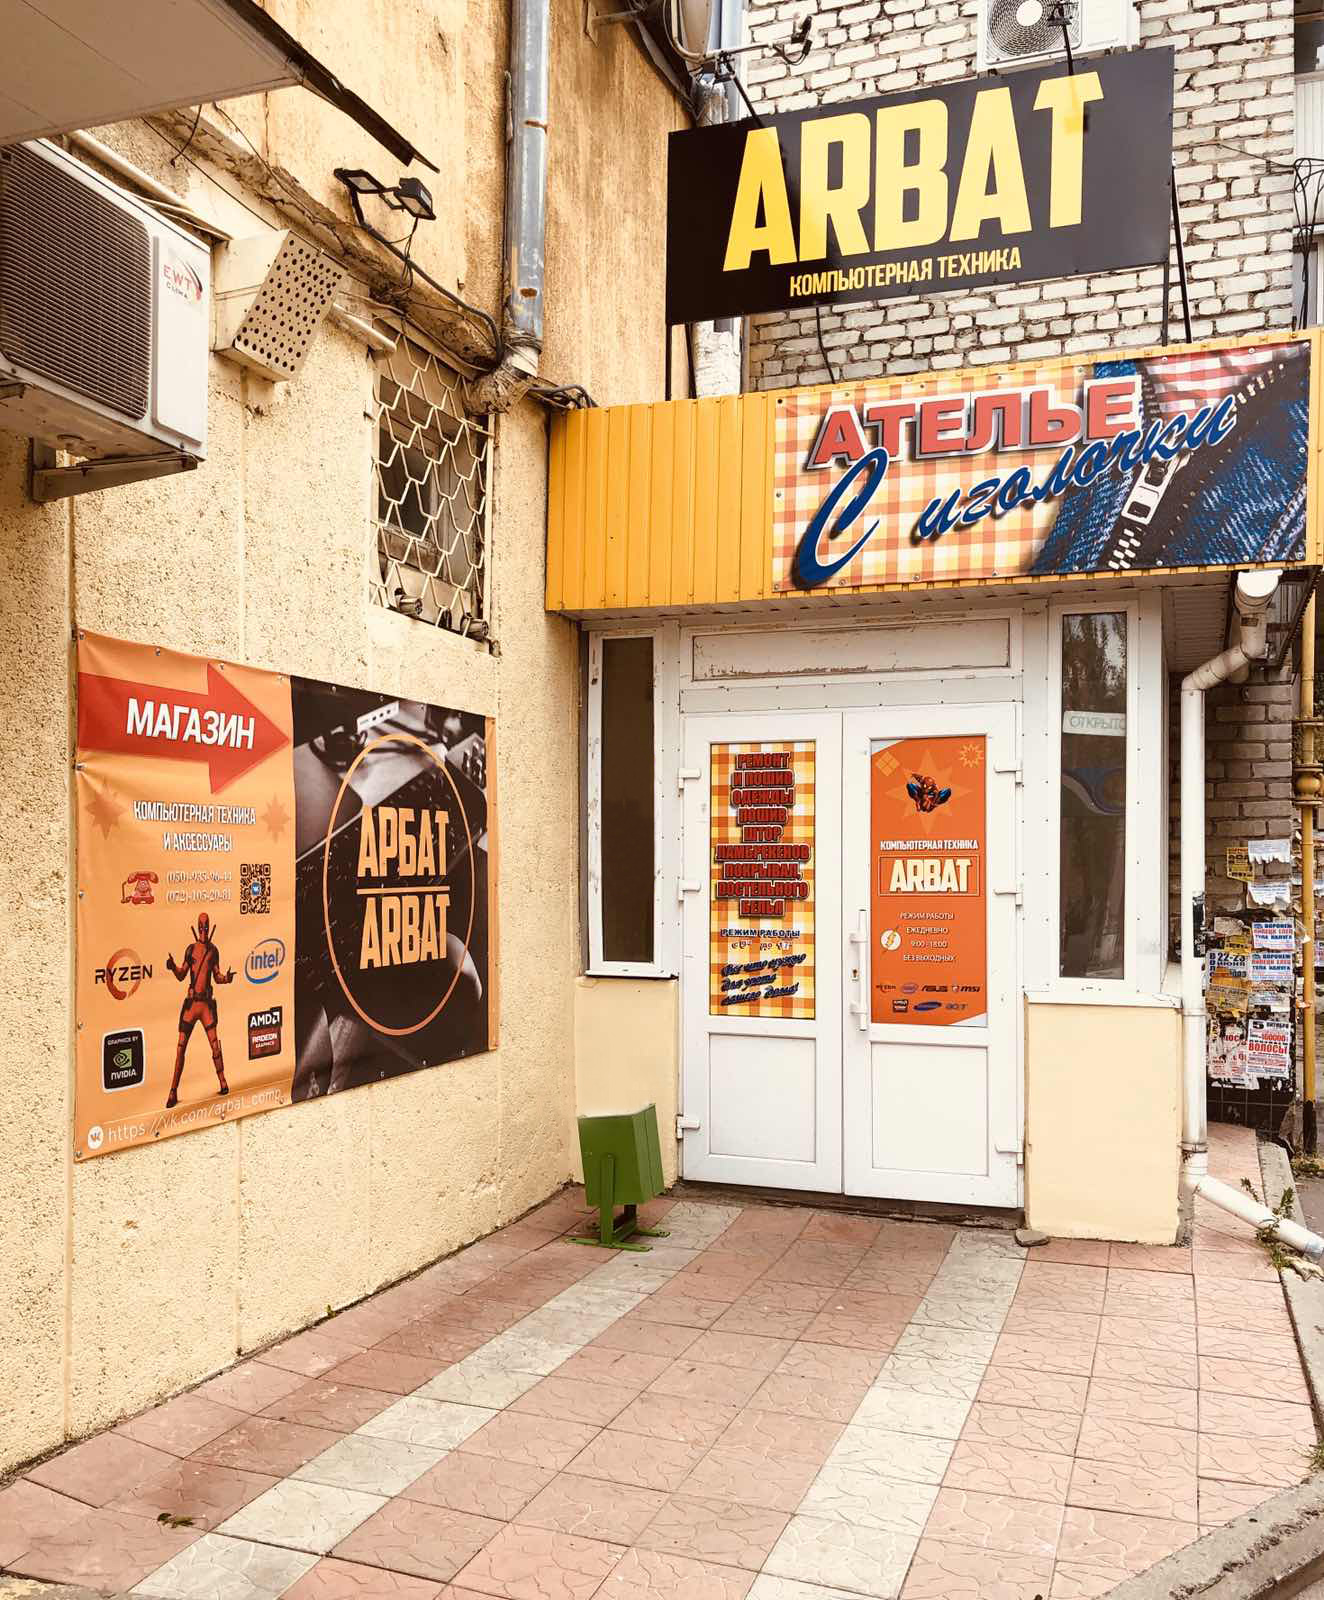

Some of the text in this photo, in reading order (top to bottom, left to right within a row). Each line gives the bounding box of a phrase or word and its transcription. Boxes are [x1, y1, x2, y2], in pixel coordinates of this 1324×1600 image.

[722, 71, 1105, 272] ARBAT
[789, 246, 1022, 298] КОМПЬЮТЕРНАЯ ТЕХНИКА
[809, 376, 1141, 470] АТЕЛЬЕ
[797, 394, 1236, 588] С иголочки
[126, 697, 256, 750] МАГАЗИН
[736, 752, 791, 769] РЕМОНТ
[744, 769, 795, 787] ПОШИВ
[731, 788, 795, 807] ОДЕЖДЫ
[133, 800, 257, 826] КОМПЬЮТЕРНАЯ ТЕХНИКА
[738, 806, 788, 824] ПОШИВ
[162, 832, 232, 852] И АКСЕССУАРЫ
[356, 805, 449, 878] АРБАТ
[742, 825, 783, 843] ШТОР
[880, 839, 979, 850] КОМПЬЮТЕРНАЯ ТЕХНИКА
[889, 858, 972, 893] ARBAT
[740, 899, 785, 916] БЕЛЬЯ
[926, 912, 954, 920] РАБОТЫ
[359, 894, 450, 970] ARBAT
[721, 928, 801, 939] РЕЖИМ РАБОТЫ
[250, 951, 280, 971] intel
[95, 964, 153, 985] RYZEN
[250, 1013, 272, 1028] AMD
[1248, 1043, 1288, 1055] ВОЛОСЫ
